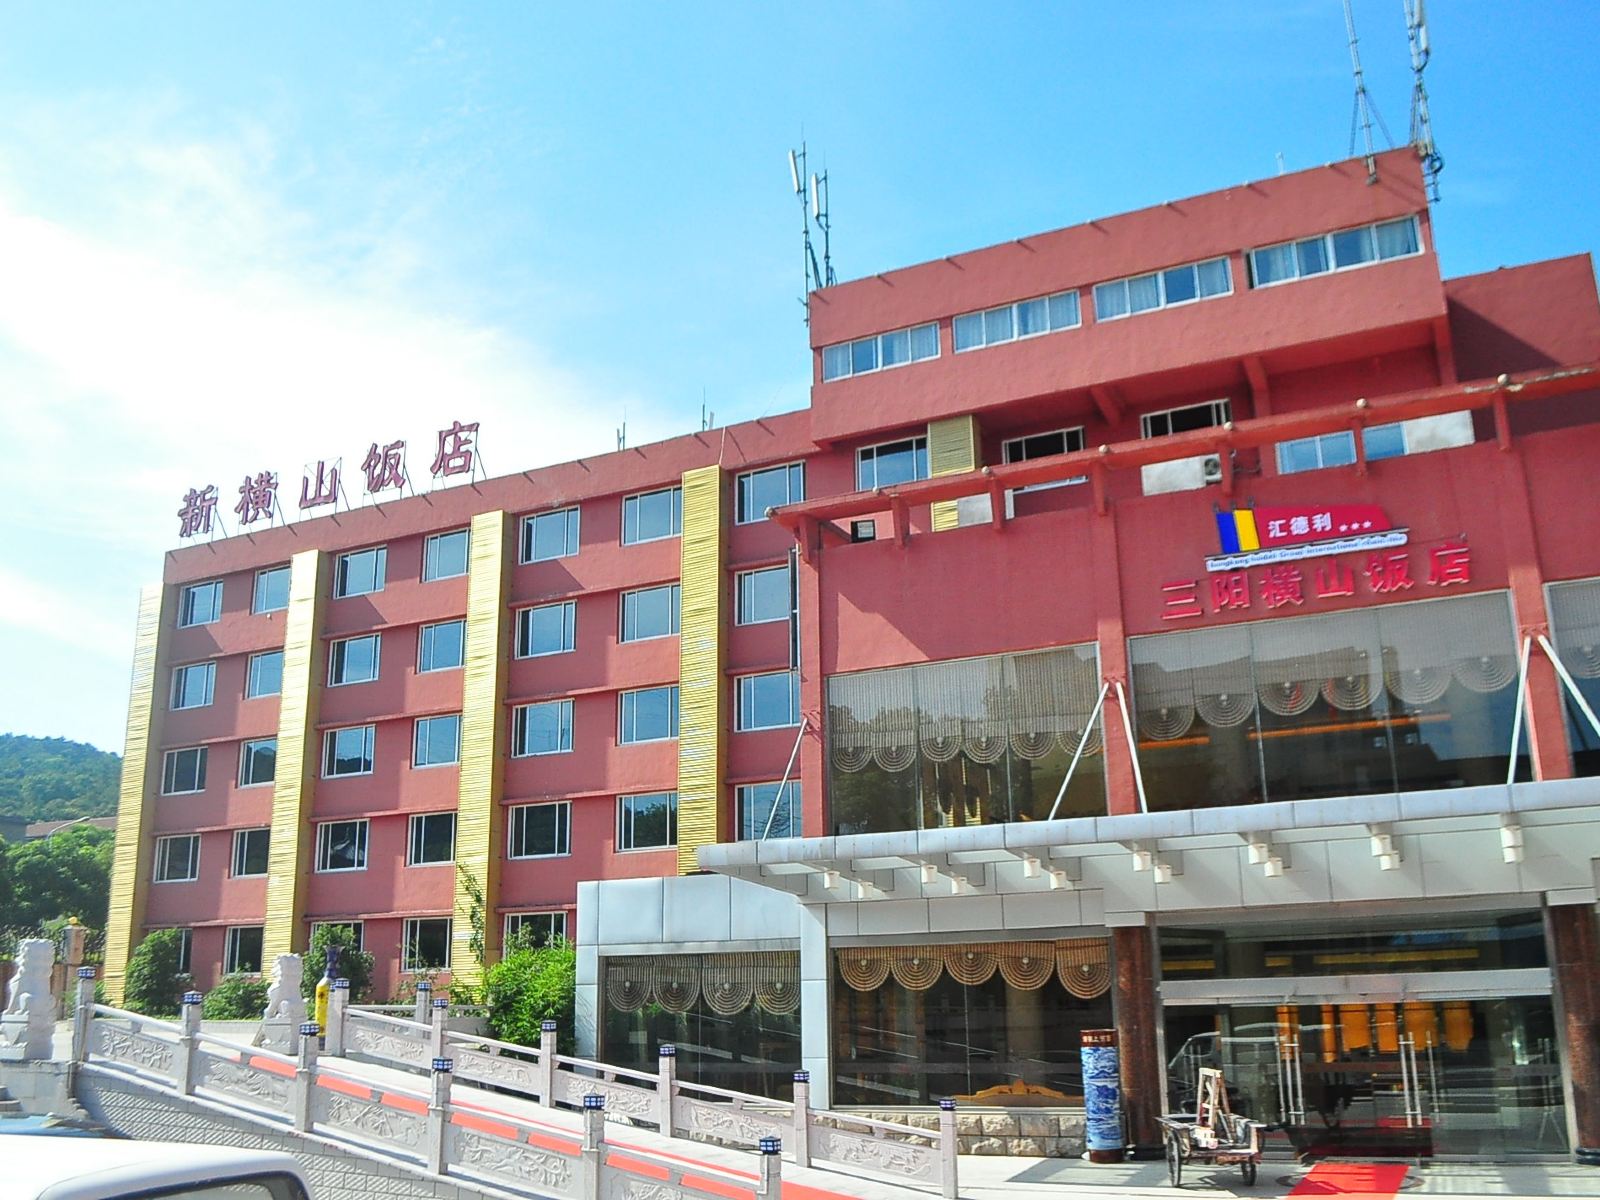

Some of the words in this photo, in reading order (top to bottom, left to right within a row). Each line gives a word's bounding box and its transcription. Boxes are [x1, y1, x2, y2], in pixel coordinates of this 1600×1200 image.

[177, 420, 480, 538] 新横山饭店
[1267, 511, 1332, 538] 汇德利
[1161, 542, 1471, 620] 三阳横山饭店
